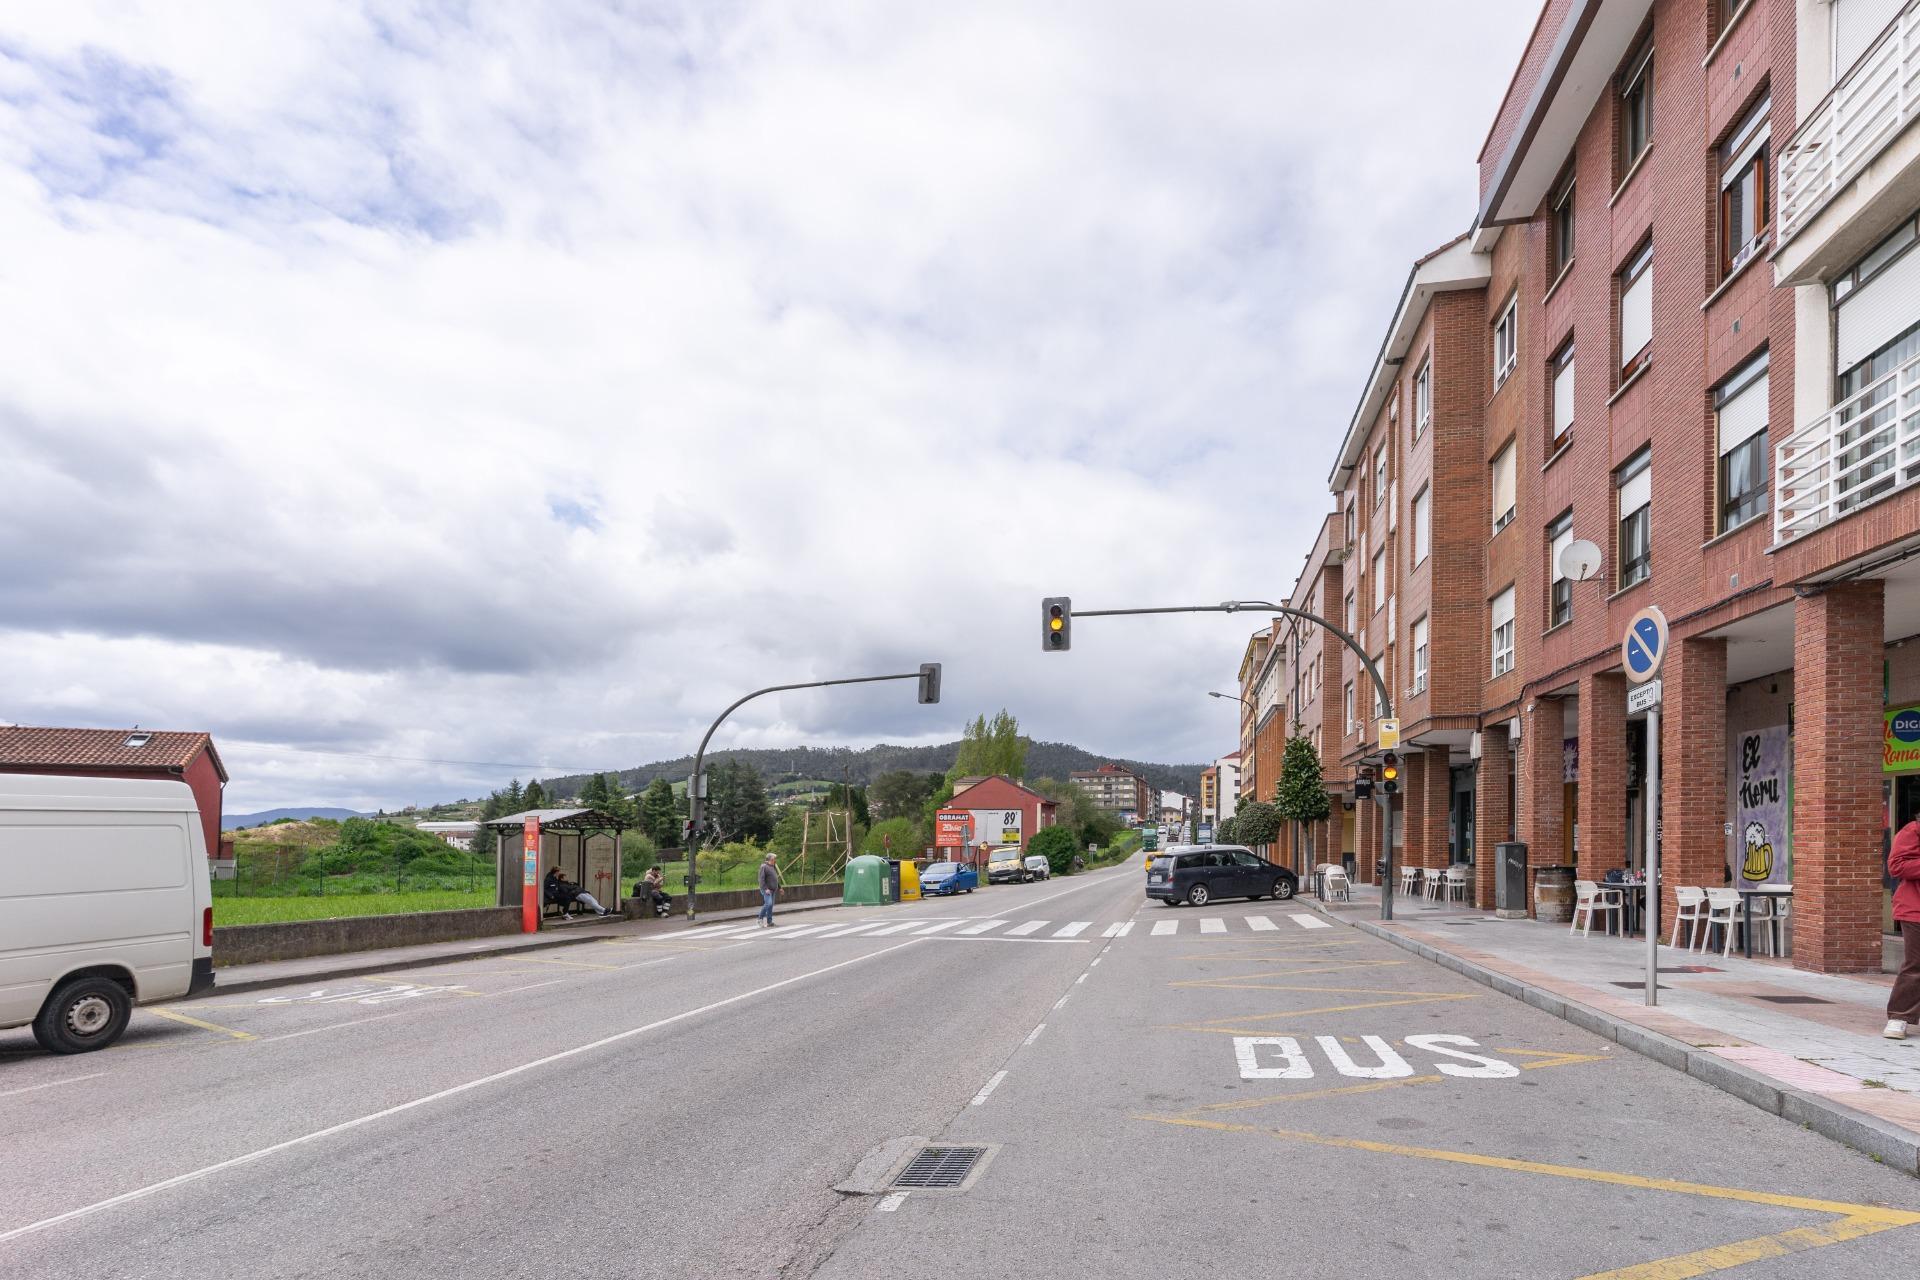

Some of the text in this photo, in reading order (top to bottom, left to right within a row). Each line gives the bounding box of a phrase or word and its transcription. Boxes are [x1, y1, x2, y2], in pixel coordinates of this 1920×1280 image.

[1636, 699, 1647, 708] BUS
[1742, 734, 1761, 773] El
[1232, 1034, 1521, 1079] BUS
